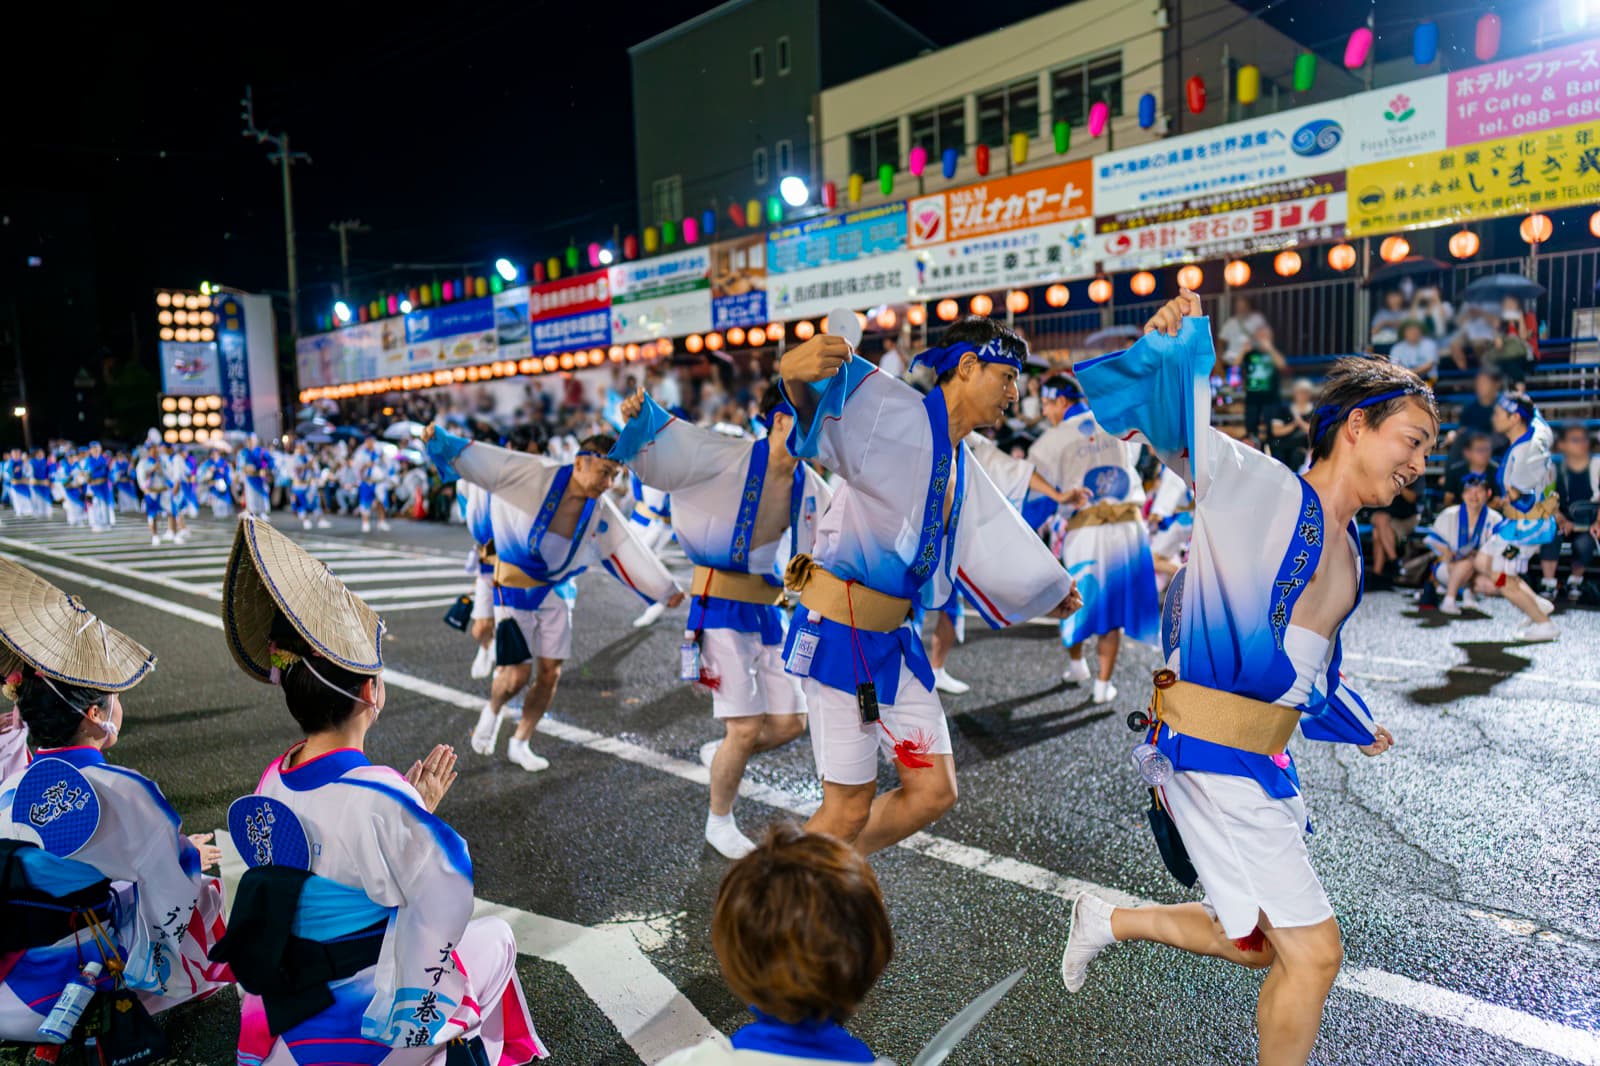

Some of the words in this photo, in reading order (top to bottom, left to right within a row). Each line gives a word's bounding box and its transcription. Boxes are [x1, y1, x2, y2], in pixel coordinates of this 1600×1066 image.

[1484, 93, 1532, 113] Cafe
[1541, 85, 1556, 102] &
[950, 182, 1083, 228] マルナカマート
